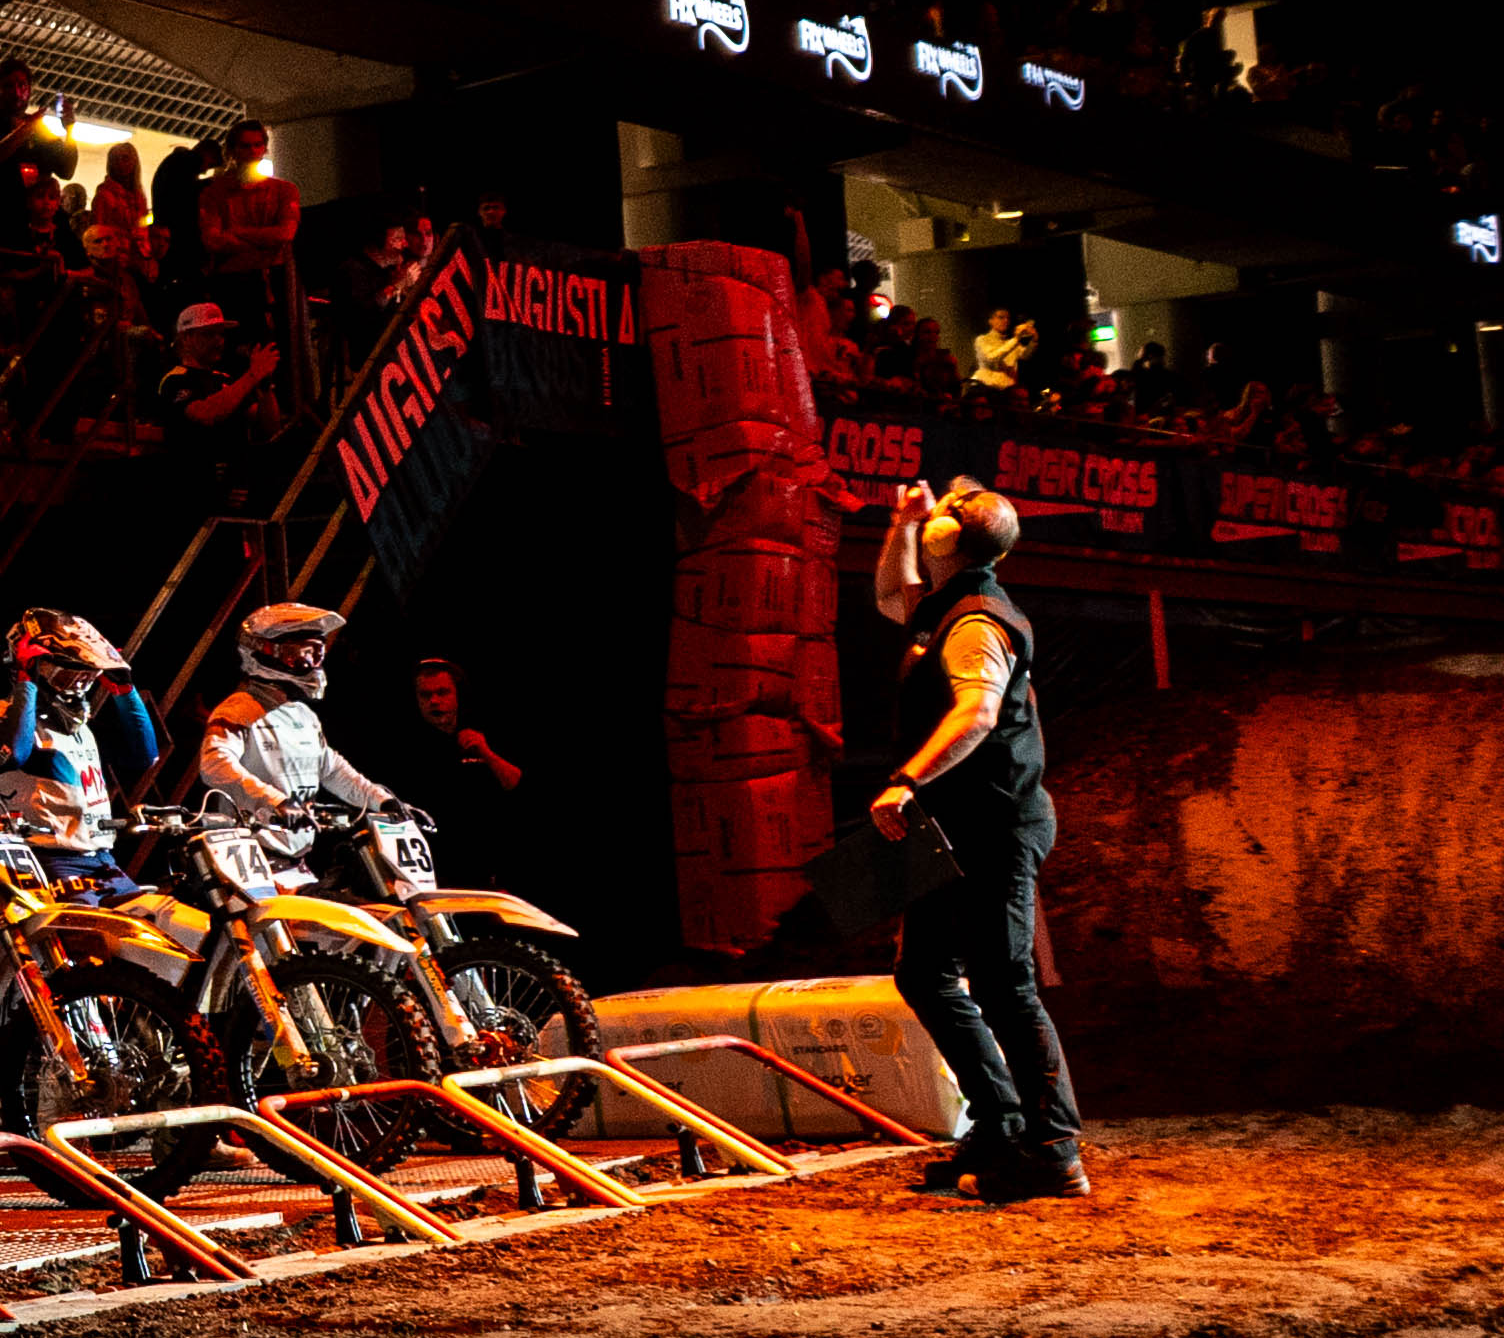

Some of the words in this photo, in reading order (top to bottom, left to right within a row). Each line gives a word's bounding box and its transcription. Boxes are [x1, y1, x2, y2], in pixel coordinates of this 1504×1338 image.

[829, 417, 924, 478] CROSS
[1083, 454, 1158, 508] CROSS
[396, 836, 434, 874] 43
